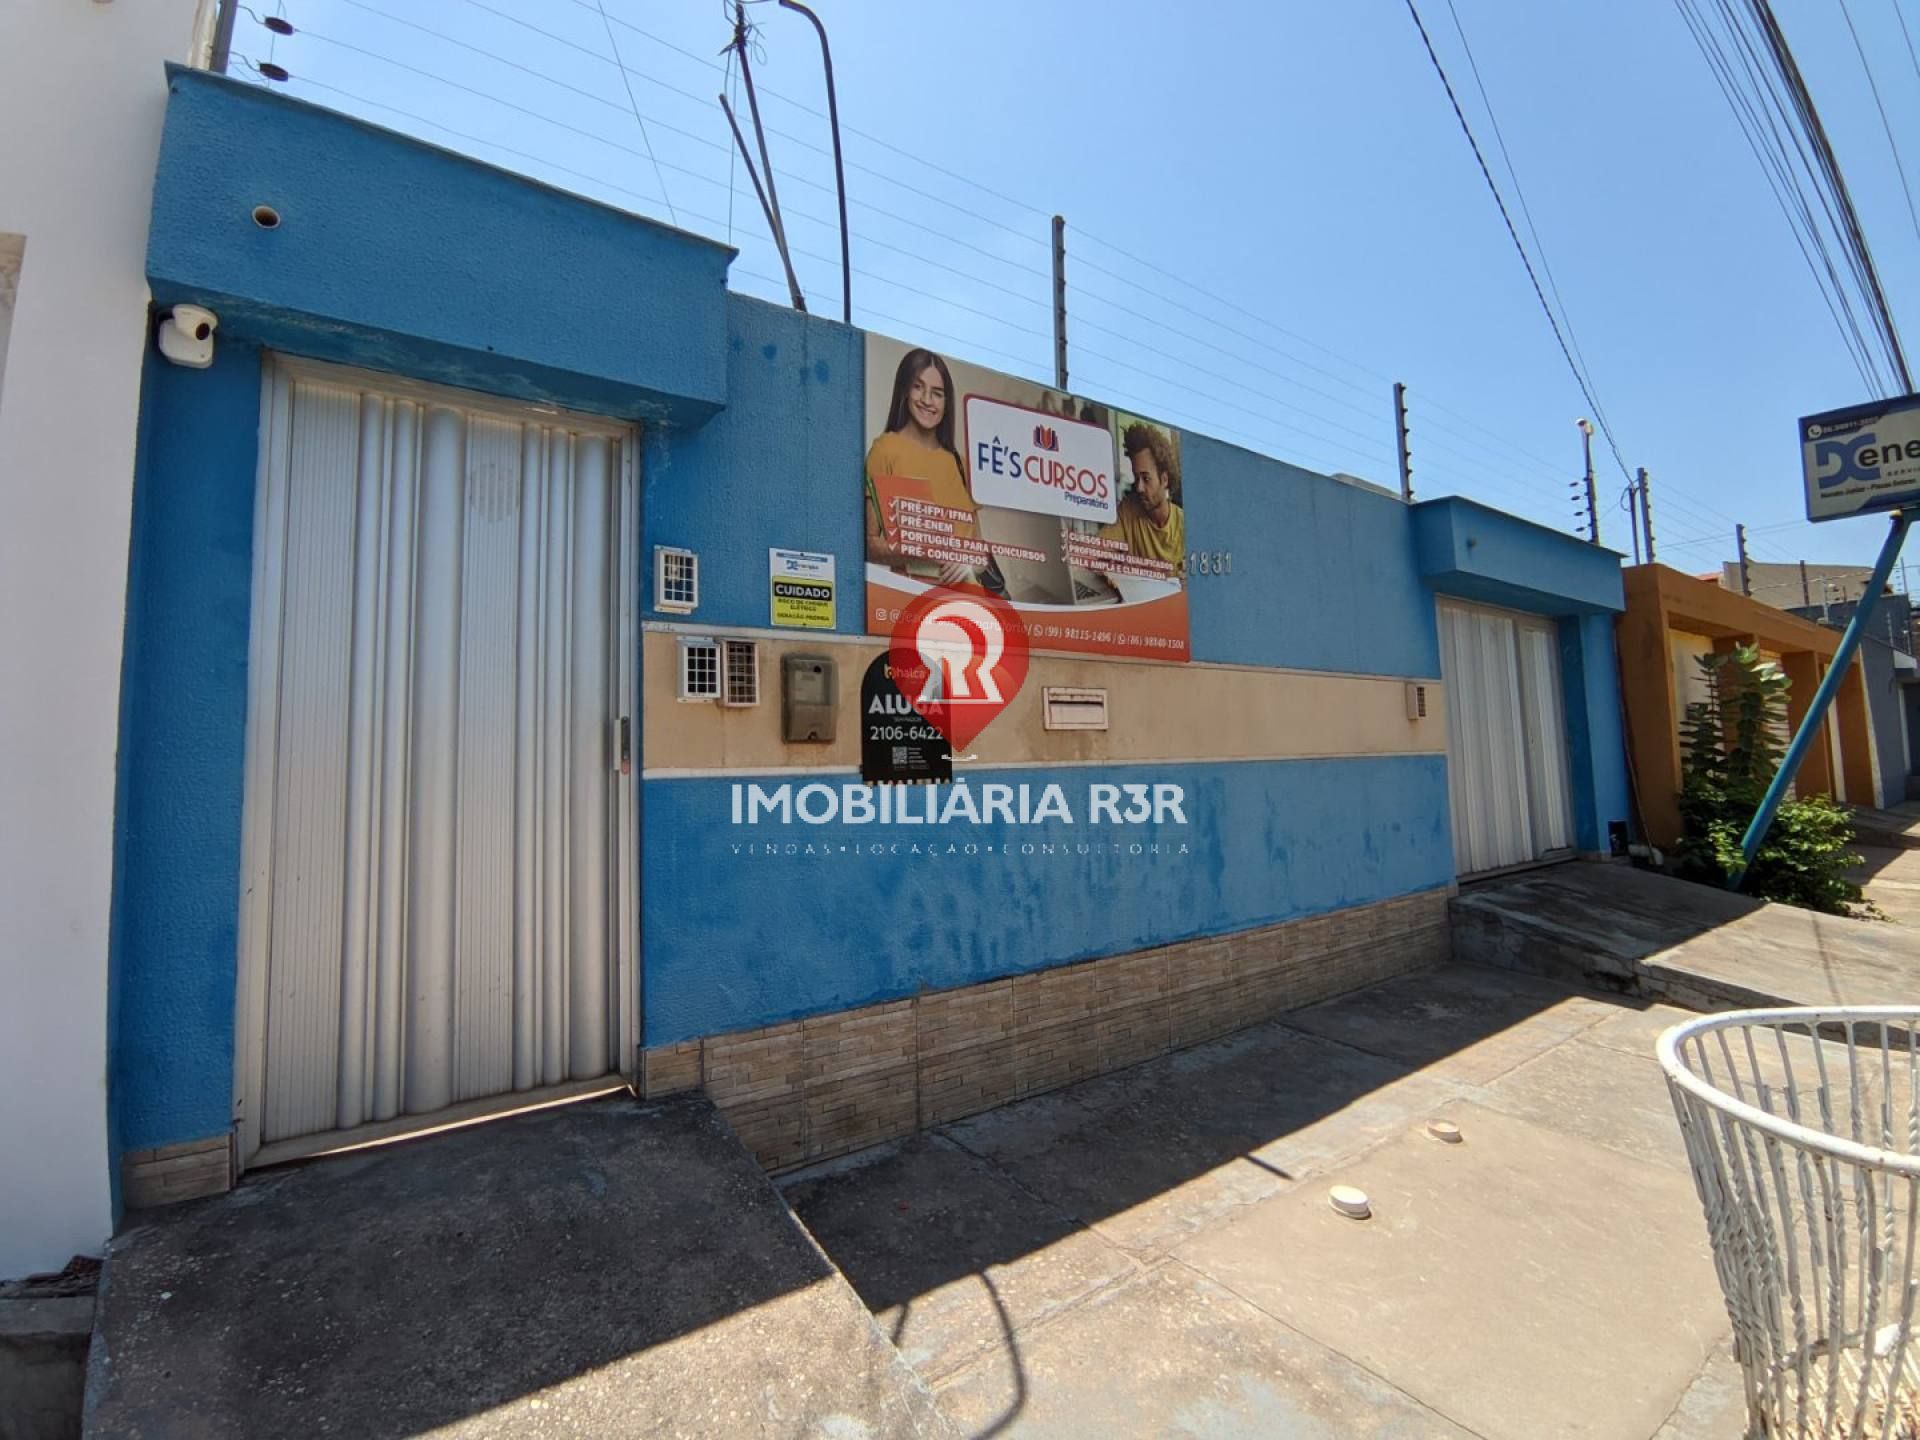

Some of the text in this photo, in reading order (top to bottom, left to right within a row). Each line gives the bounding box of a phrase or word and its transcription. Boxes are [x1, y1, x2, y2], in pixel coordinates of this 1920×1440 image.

[1024, 455, 1108, 499] CURSOS
[901, 500, 973, 523] PRÉ-IFPI/IFMA
[901, 515, 953, 533] PRÉ-ENEM
[901, 529, 1046, 563] PORTUGUÊS PARA CONCURSOS
[1069, 532, 1129, 551] CURSOS LIVRES
[927, 549, 989, 566] CONCURSOS
[1069, 544, 1124, 562] PROFISSIONAIS
[1070, 556, 1088, 567] SALA
[1190, 551, 1231, 575] 1831
[775, 584, 830, 598] CUIDADO
[868, 694, 944, 715] ALUGA
[870, 726, 944, 740] 2106-6422
